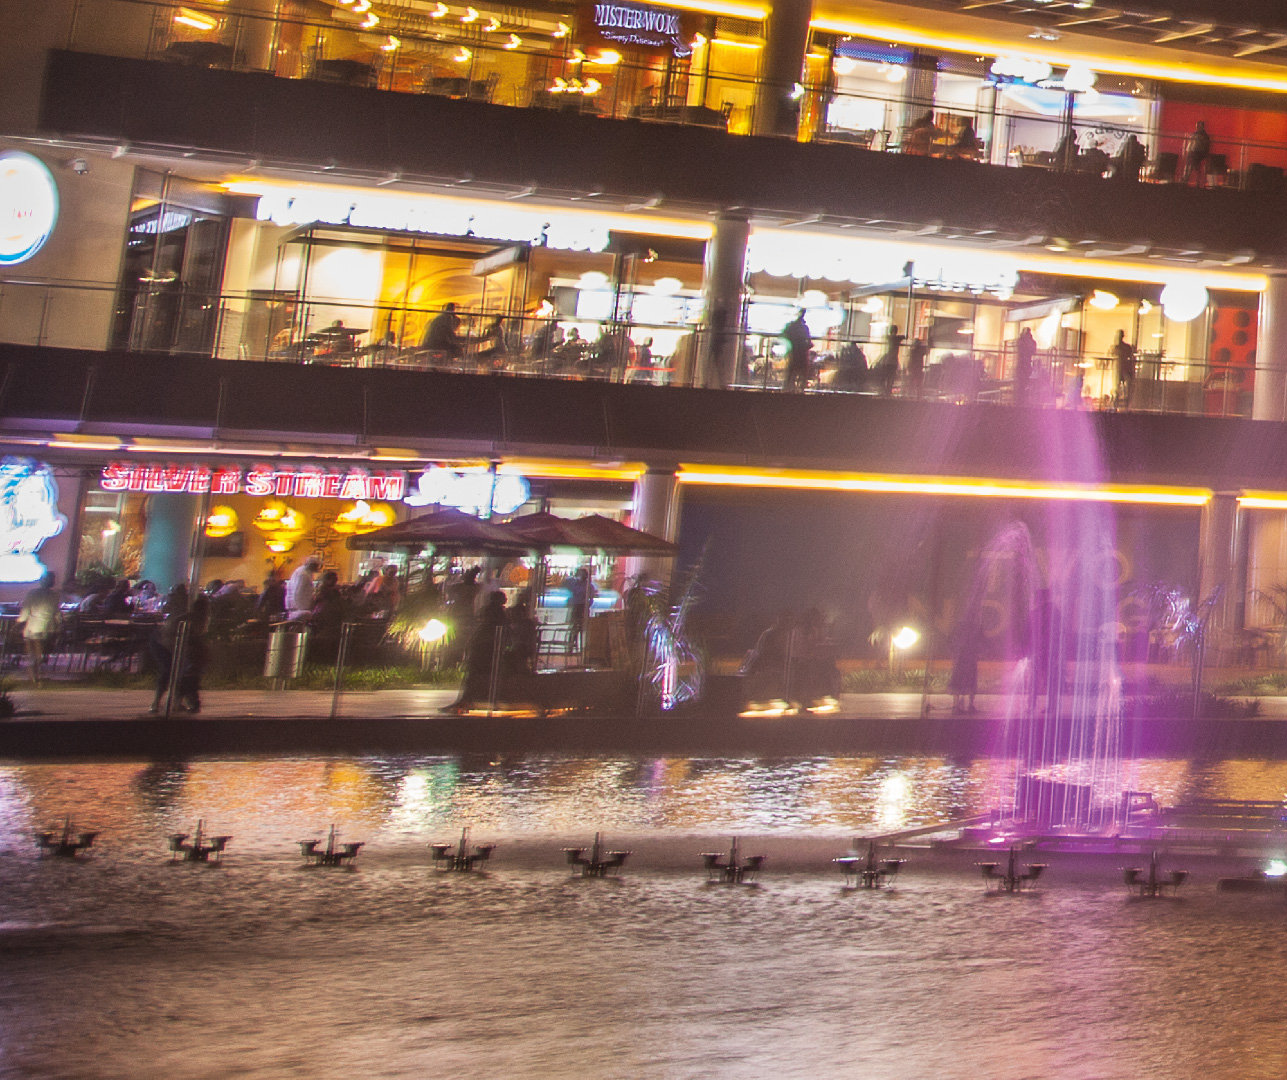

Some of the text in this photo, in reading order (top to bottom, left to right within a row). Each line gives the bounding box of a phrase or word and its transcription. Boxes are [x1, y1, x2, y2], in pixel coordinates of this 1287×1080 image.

[594, 4, 678, 35] MISTER WOK
[101, 465, 241, 493] SILVER
[245, 470, 405, 500] STREAM
